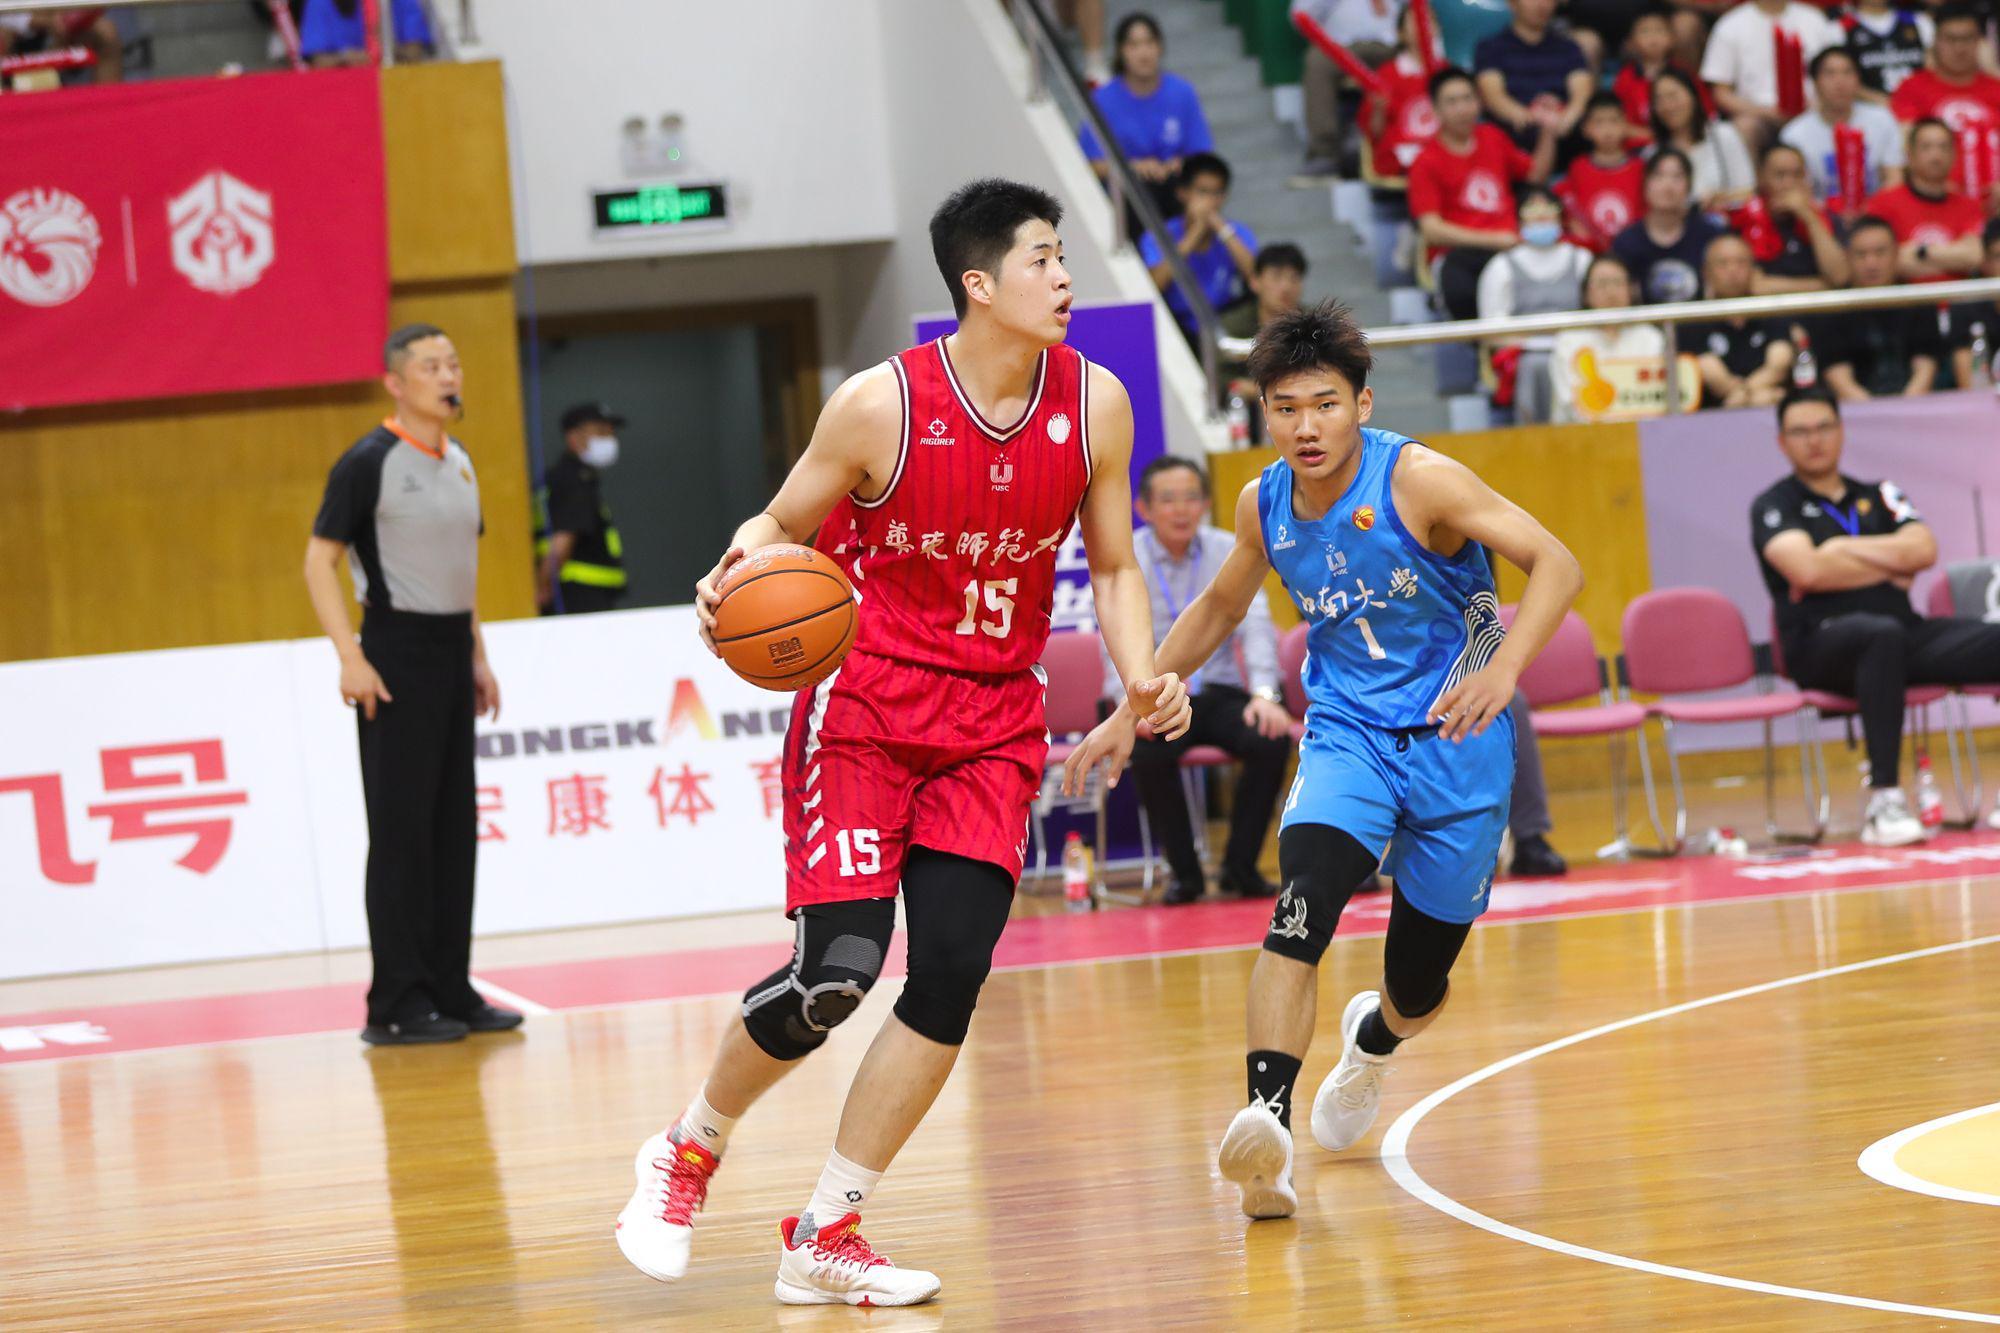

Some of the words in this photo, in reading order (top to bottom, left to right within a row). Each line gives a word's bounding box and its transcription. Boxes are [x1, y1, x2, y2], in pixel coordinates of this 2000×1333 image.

[919, 437, 955, 446] RIGORER
[991, 484, 1010, 492] FUSC
[955, 577, 1019, 639] 15
[768, 636, 803, 658] FIBA
[1353, 617, 1387, 661] 1
[475, 678, 793, 760] ONGKAN
[835, 828, 881, 877] 15
